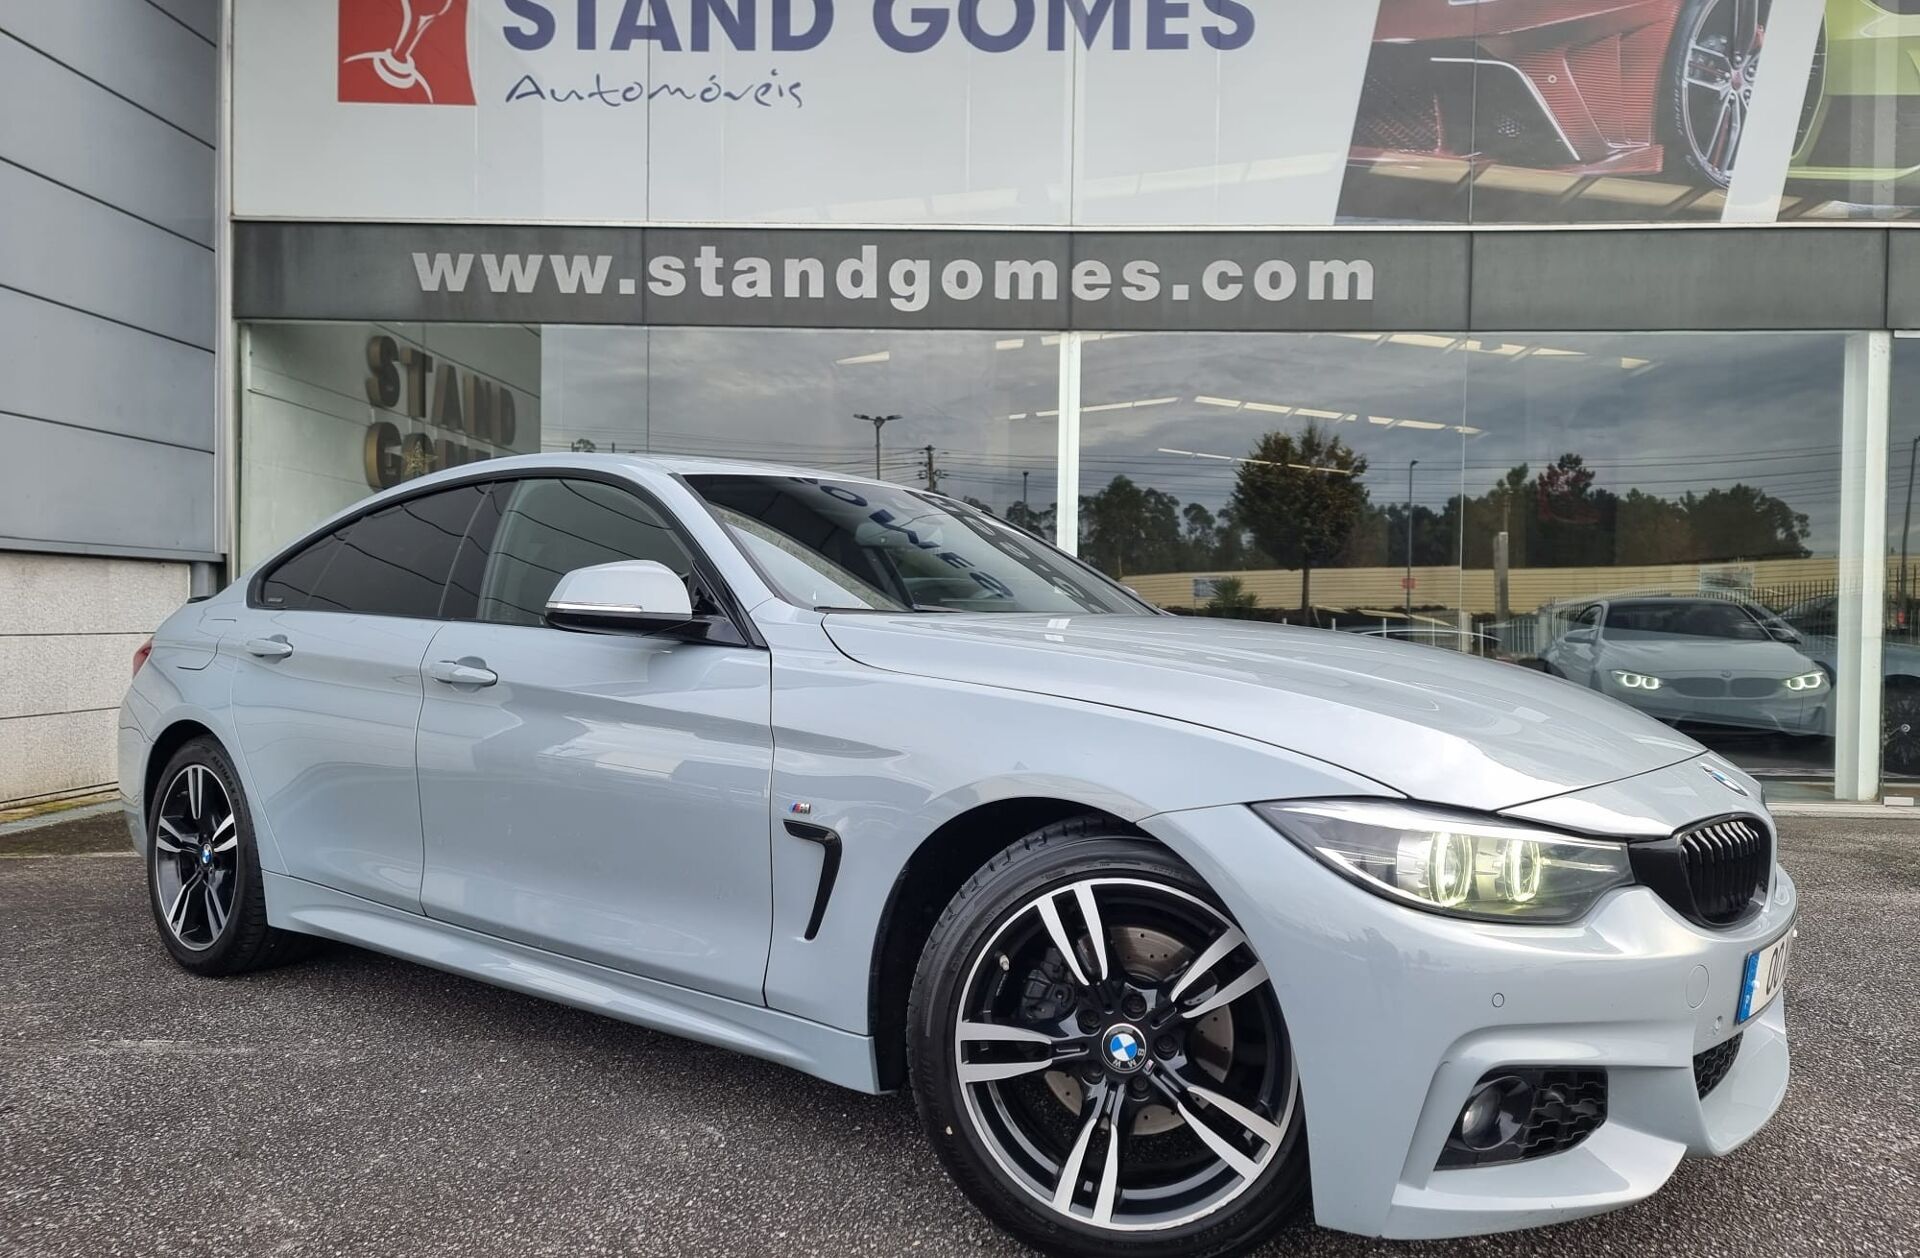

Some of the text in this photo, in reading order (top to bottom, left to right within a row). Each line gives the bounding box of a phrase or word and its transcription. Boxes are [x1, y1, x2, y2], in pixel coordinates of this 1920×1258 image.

[503, 0, 1255, 53] STAND GOMES
[412, 245, 1374, 312] www.standgomes.com
[366, 335, 516, 445] STAND
